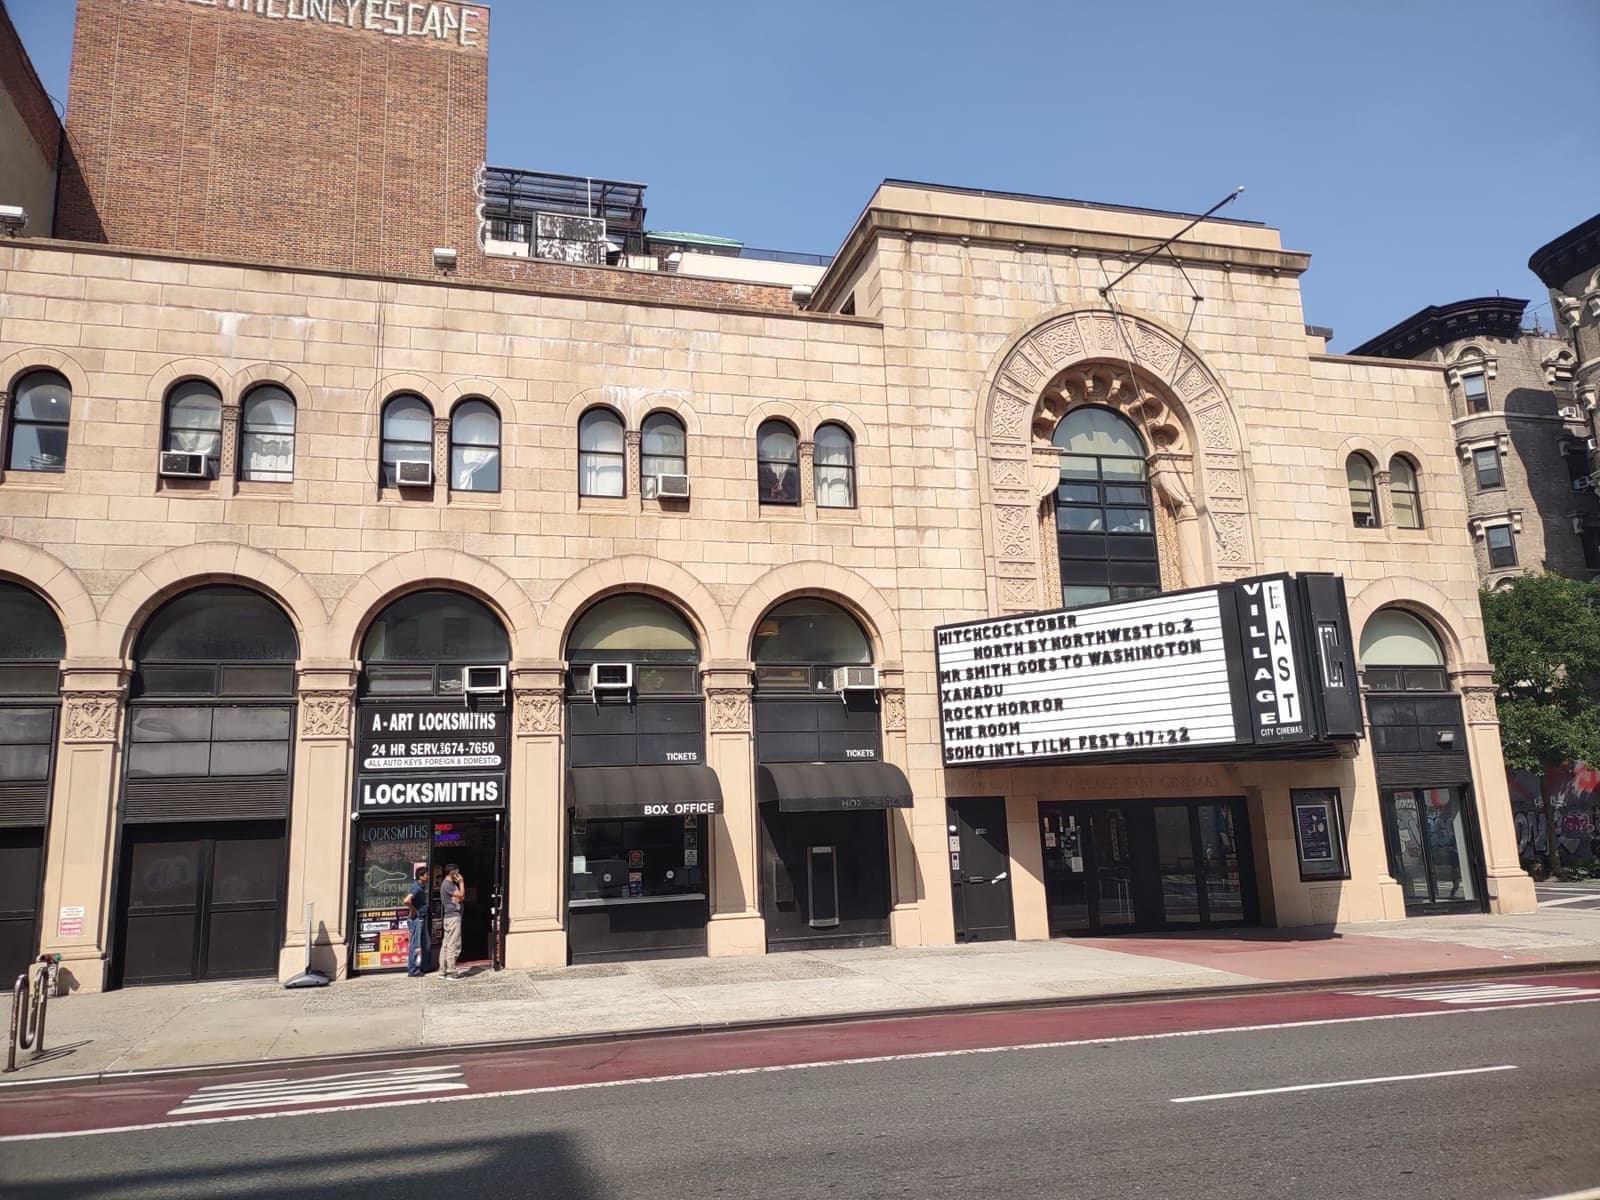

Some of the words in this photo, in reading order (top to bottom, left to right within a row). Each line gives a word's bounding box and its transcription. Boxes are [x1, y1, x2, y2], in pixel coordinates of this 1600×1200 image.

[939, 615, 1077, 646] HITCHCOCKTOBER
[973, 641, 1024, 660] NORTH
[1028, 638, 1048, 654] BY
[1051, 623, 1153, 651] NORTHWEST
[1242, 582, 1277, 725] VILLAGE
[1268, 585, 1295, 718] EAST
[940, 669, 960, 684] MR
[966, 663, 1012, 680] SMITH
[1017, 658, 1058, 675] GOES
[1061, 654, 1083, 669] TO
[1088, 639, 1202, 667] WASHINGTON
[942, 684, 1004, 703] XANADU
[944, 704, 993, 722] ROCKY
[997, 698, 1063, 716] HORROR
[419, 712, 496, 731] LOCKSMITHS
[946, 726, 972, 741] THE
[978, 721, 1020, 738] ROOM
[1260, 728, 1275, 737] CITY
[1276, 726, 1303, 736] CINEMAS
[371, 744, 386, 756] 24
[390, 743, 406, 755] HR
[410, 743, 440, 755] SERV.
[445, 741, 496, 754] 674-7650
[666, 752, 697, 760] TICKETS
[846, 749, 875, 757] TICKETS
[946, 744, 985, 761] SOHO
[989, 741, 1024, 757] INTL
[1031, 737, 1071, 754] FILM
[1078, 733, 1119, 750] FEST
[404, 758, 422, 766] KEYS
[424, 757, 456, 766] FOREIGN
[463, 756, 498, 765] DOMESTIC
[364, 781, 498, 804] LOCKSMITHS
[644, 804, 669, 815] BOX
[674, 803, 715, 814] OFFICE
[363, 824, 429, 841] LOCKSMITHS
